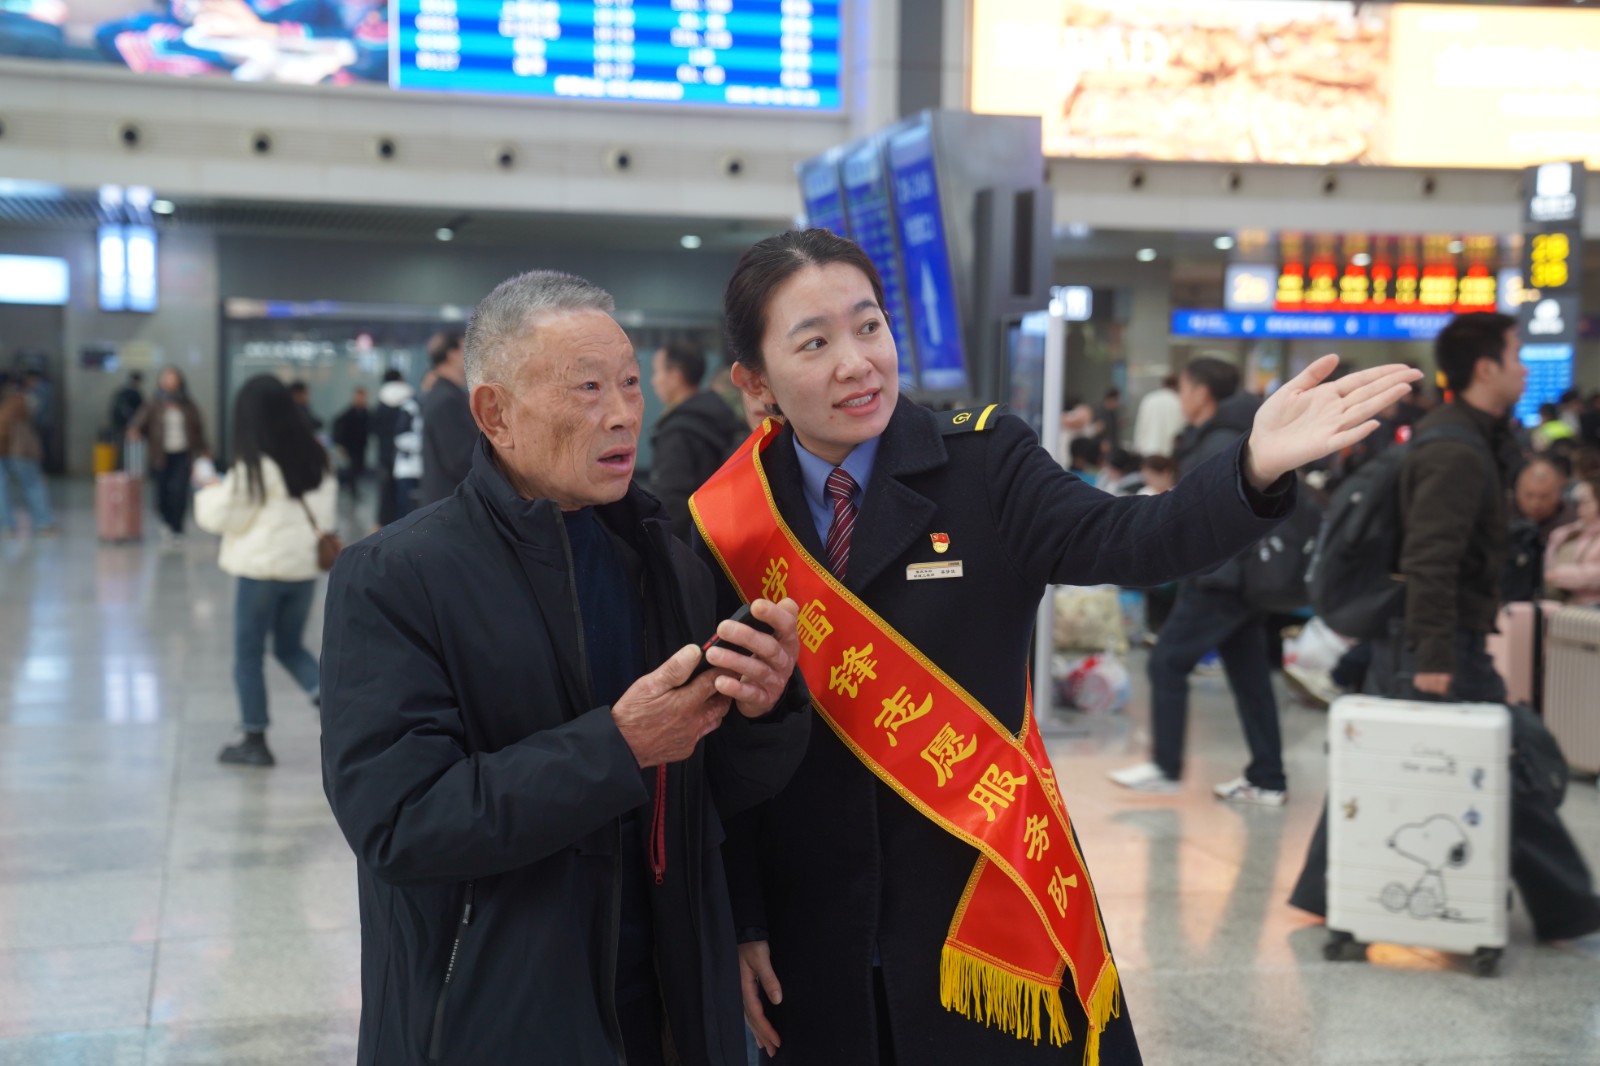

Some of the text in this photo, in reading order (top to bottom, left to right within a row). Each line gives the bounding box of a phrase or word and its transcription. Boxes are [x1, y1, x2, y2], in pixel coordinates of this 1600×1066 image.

[762, 556, 1078, 919] 学雷锋志愿服务队
